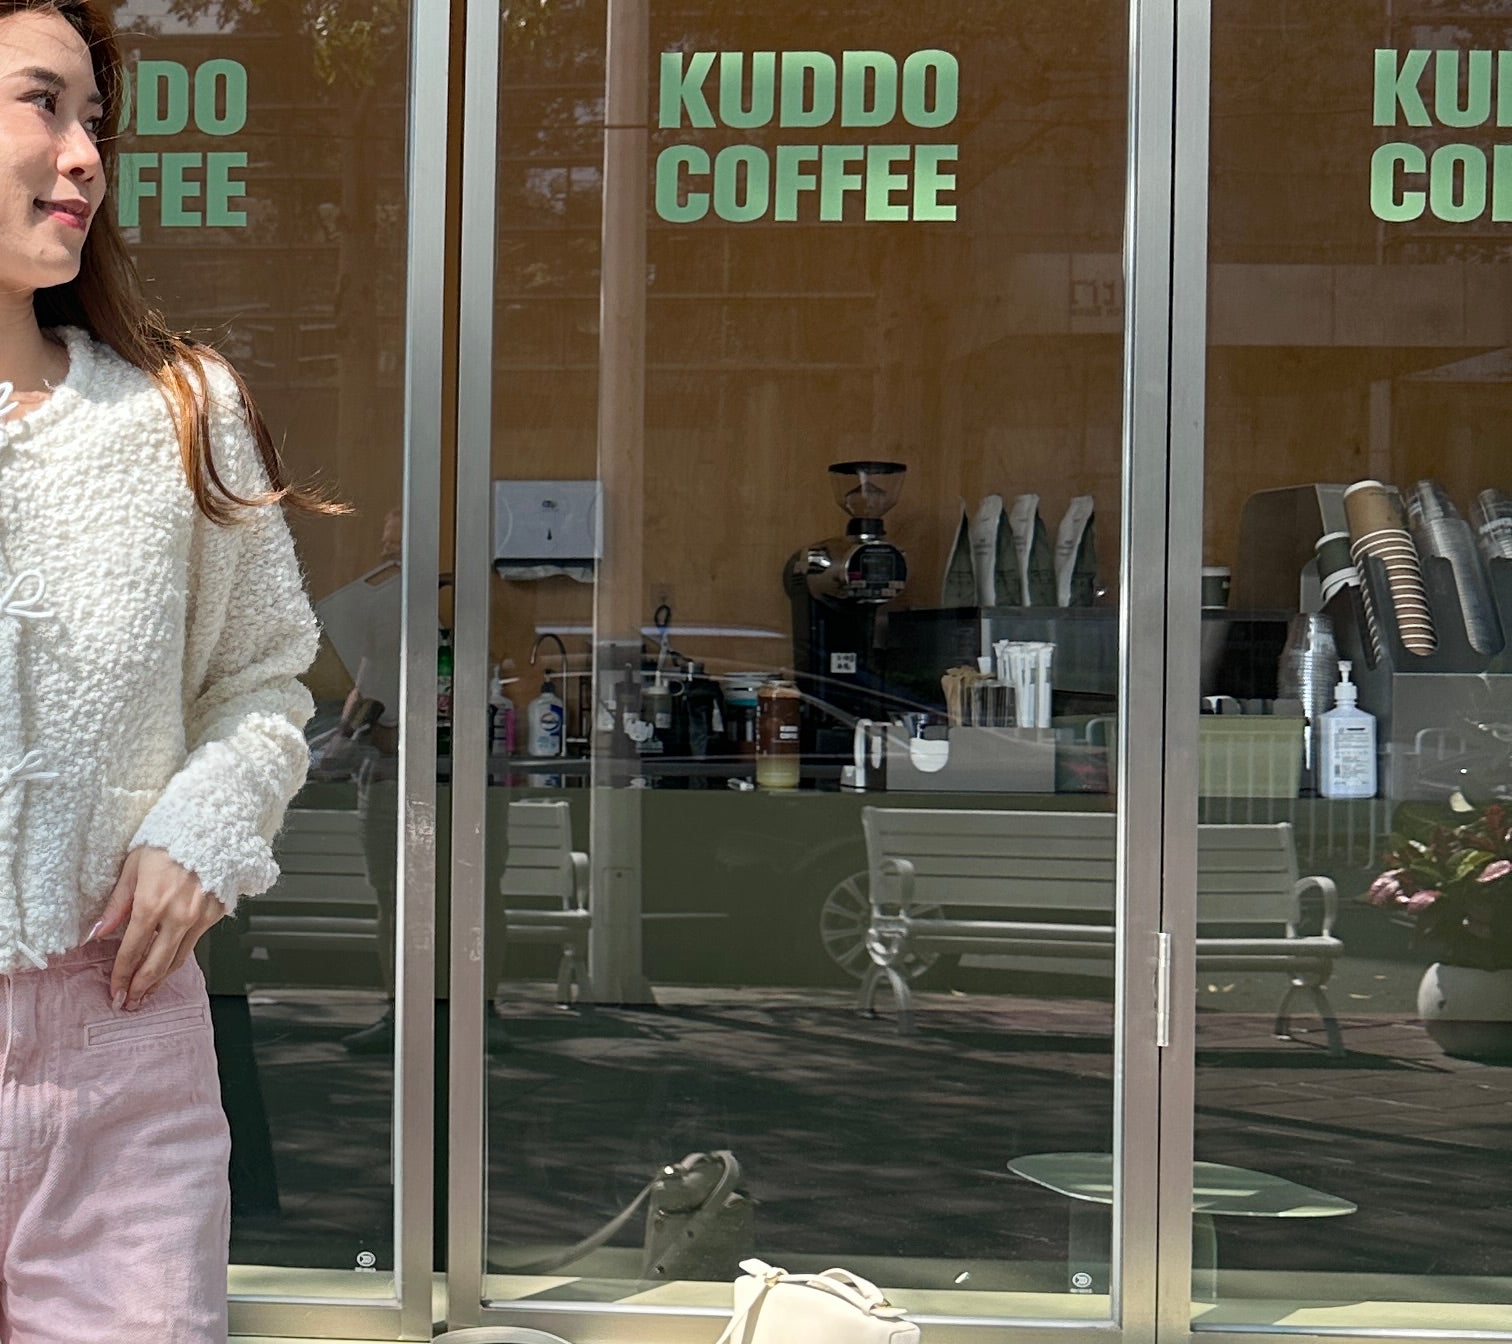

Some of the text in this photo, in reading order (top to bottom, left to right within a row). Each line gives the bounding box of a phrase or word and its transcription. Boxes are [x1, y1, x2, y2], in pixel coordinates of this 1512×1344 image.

[117, 59, 248, 136] DO
[659, 50, 959, 128] KUDDO
[1373, 49, 1512, 128] KU
[655, 145, 958, 222] COFFEE
